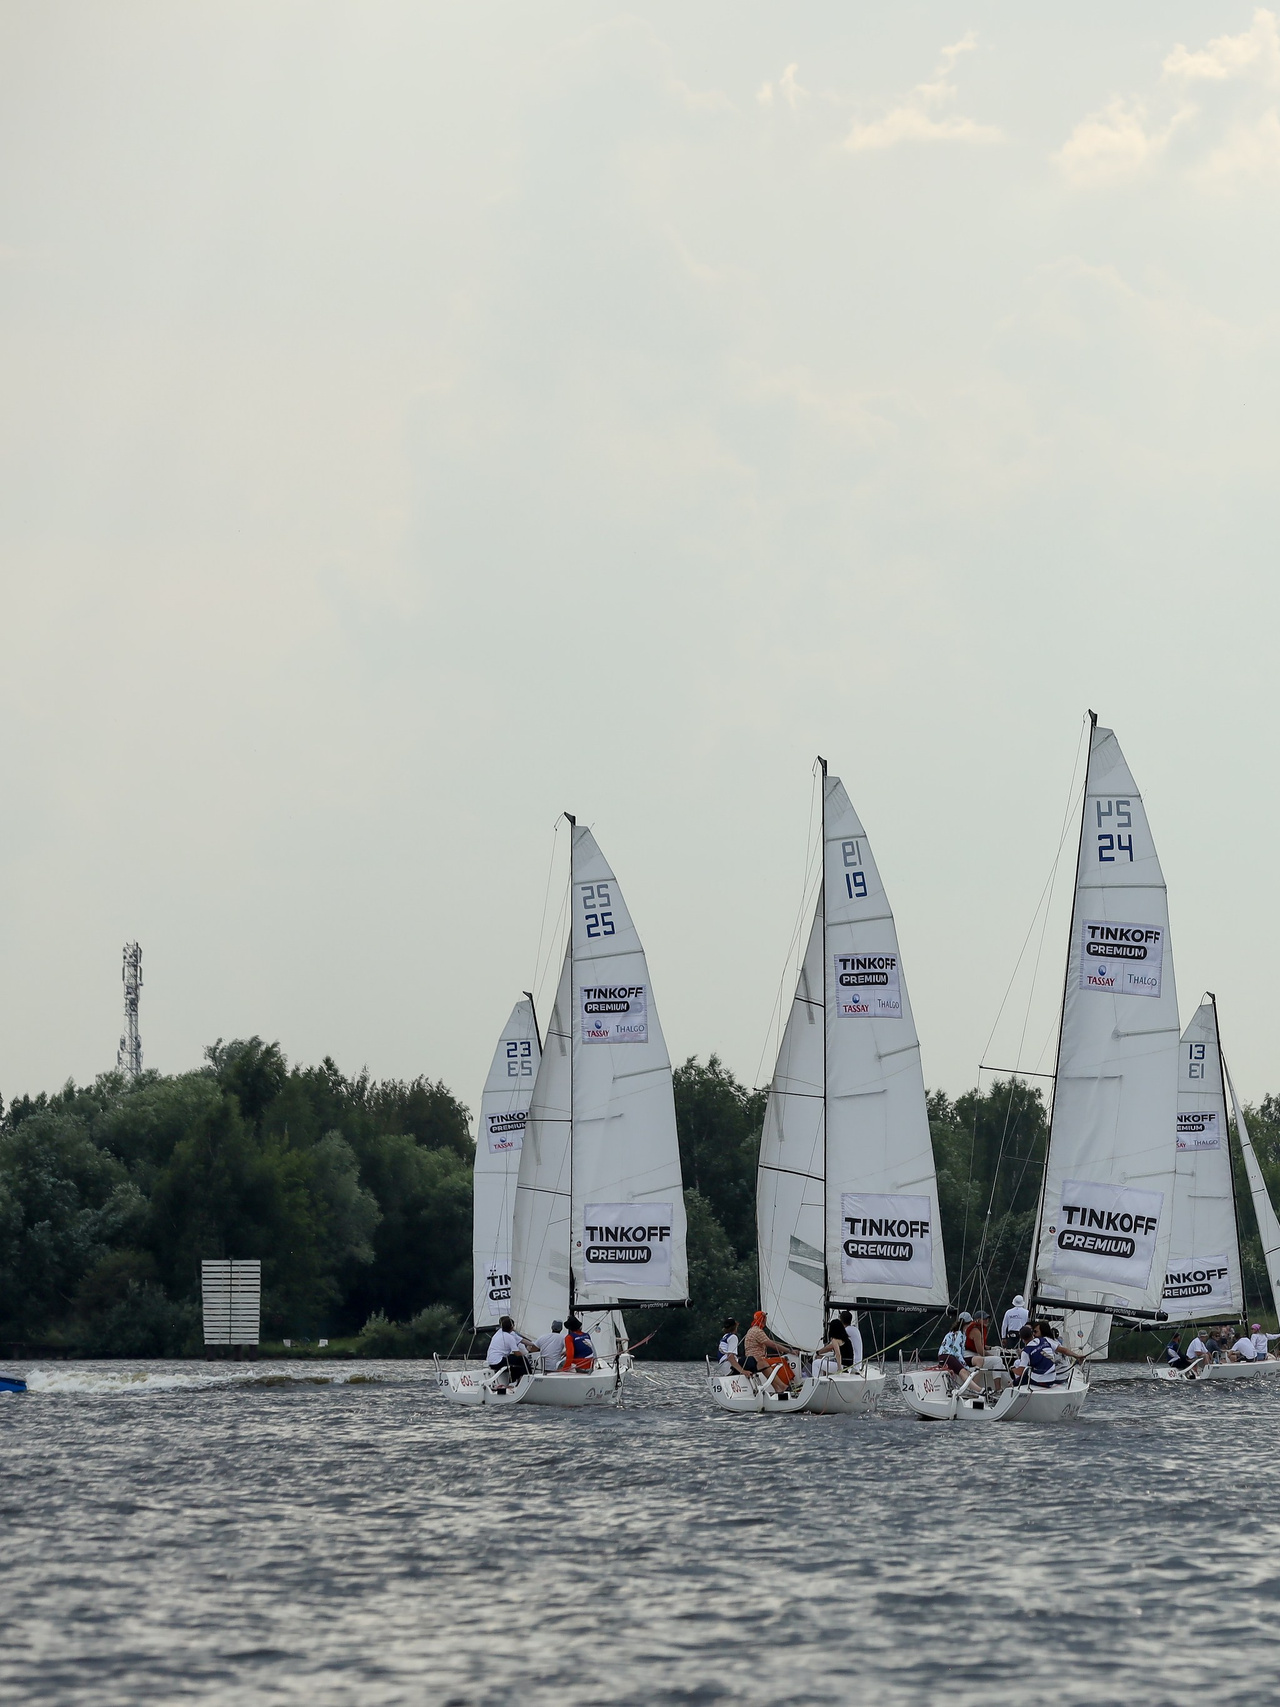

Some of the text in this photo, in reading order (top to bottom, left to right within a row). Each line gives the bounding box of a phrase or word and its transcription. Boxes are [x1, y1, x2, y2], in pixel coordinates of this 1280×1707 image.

[1098, 834, 1133, 862] 24
[846, 871, 867, 899] 19
[585, 912, 615, 938] 25
[1088, 925, 1160, 944] TINKOFF
[1090, 944, 1145, 957] PREMIUM
[839, 957, 896, 970] TINKOFF
[843, 974, 887, 984] PREMIUM
[1087, 973, 1157, 986] TASSAY THALGO
[584, 987, 643, 999] TINKOFF
[587, 1002, 628, 1011] PREMIUM
[843, 1004, 869, 1013] TASSAY
[616, 1024, 645, 1033] THALGO
[507, 1041, 531, 1058] 23
[1190, 1043, 1205, 1060] 13
[1062, 1205, 1157, 1236] TINKOFF
[586, 1226, 670, 1242] TINKOFF
[845, 1217, 929, 1239] TINKOFF
[848, 1242, 910, 1258] PREMIUM
[1062, 1233, 1132, 1255] PREMIUM
[589, 1249, 648, 1260] PREMIUM
[713, 1385, 722, 1393] 19
[902, 1384, 914, 1392] 24
